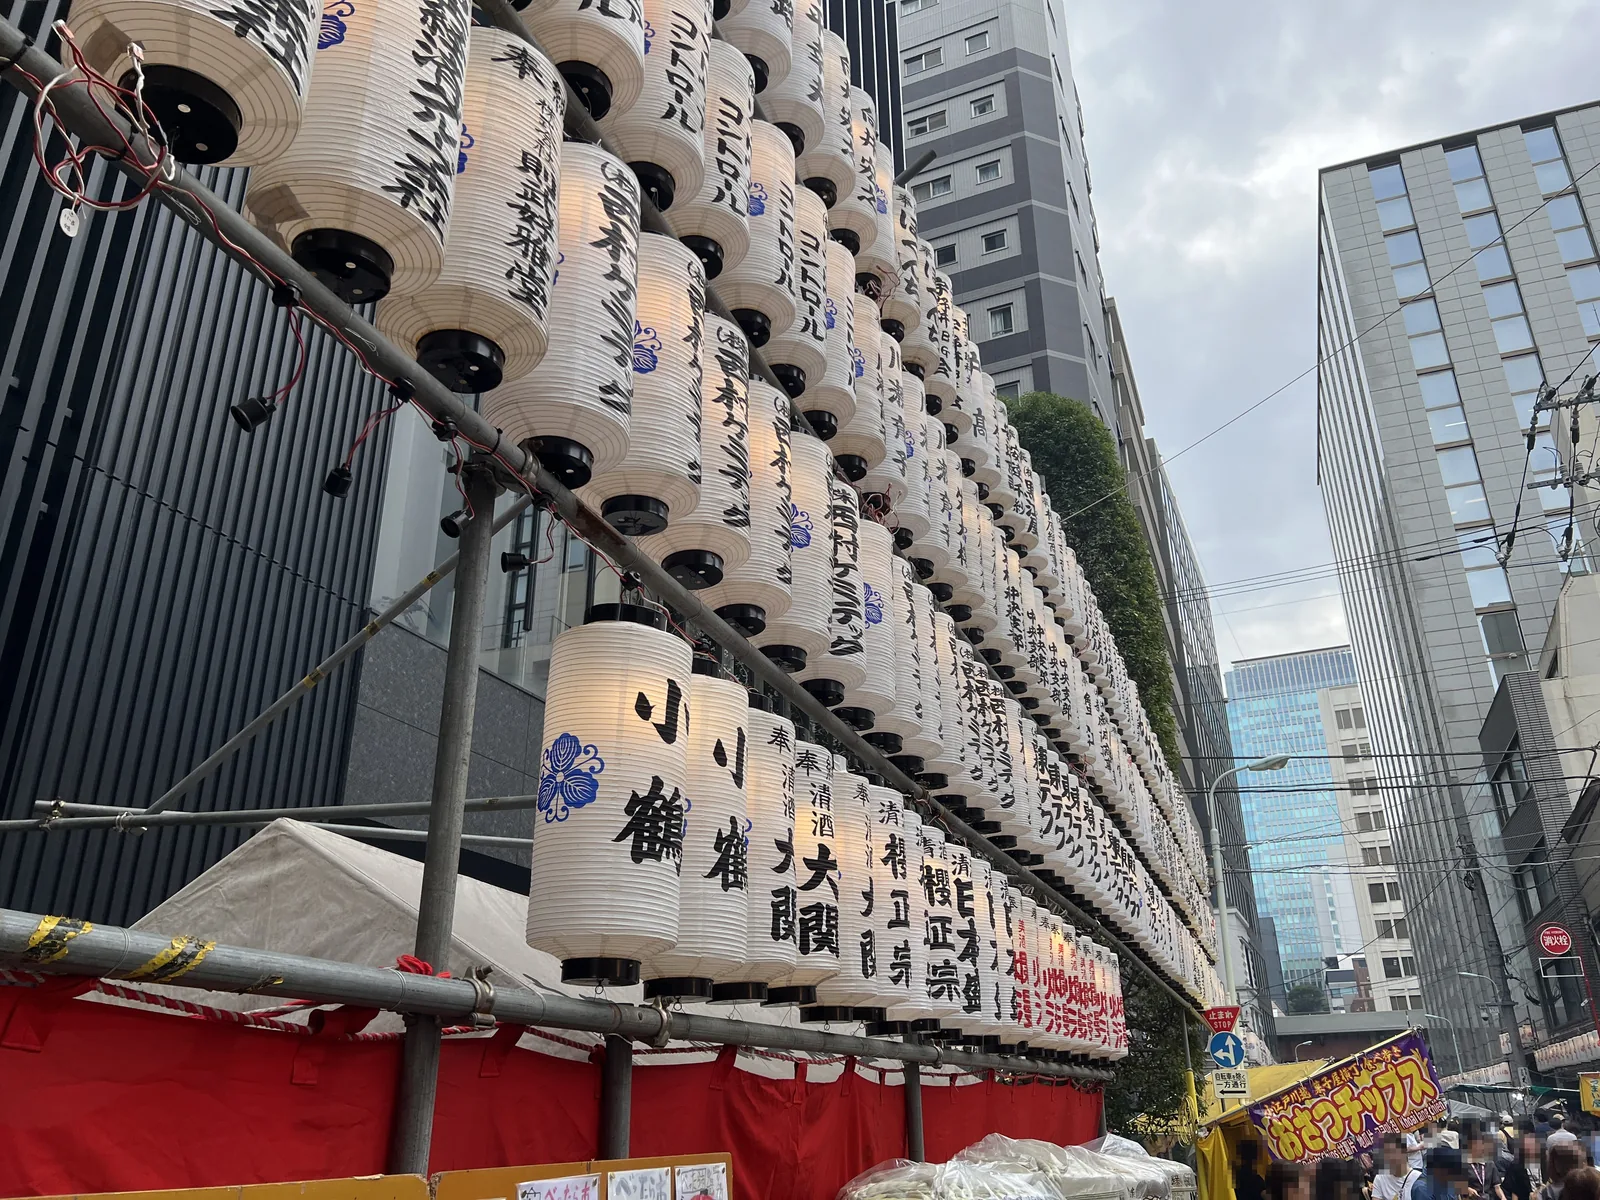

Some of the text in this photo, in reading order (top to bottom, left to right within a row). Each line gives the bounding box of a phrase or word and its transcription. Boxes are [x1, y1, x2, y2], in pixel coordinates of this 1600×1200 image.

[1543, 935, 1569, 946] 消火栓
[1209, 1011, 1233, 1020] 止まれ
[1213, 1021, 1231, 1029] STOP
[1215, 1072, 1246, 1080] 自転車を除く
[1216, 1081, 1246, 1089] 一方通行
[1267, 1056, 1440, 1163] おさつチップス
